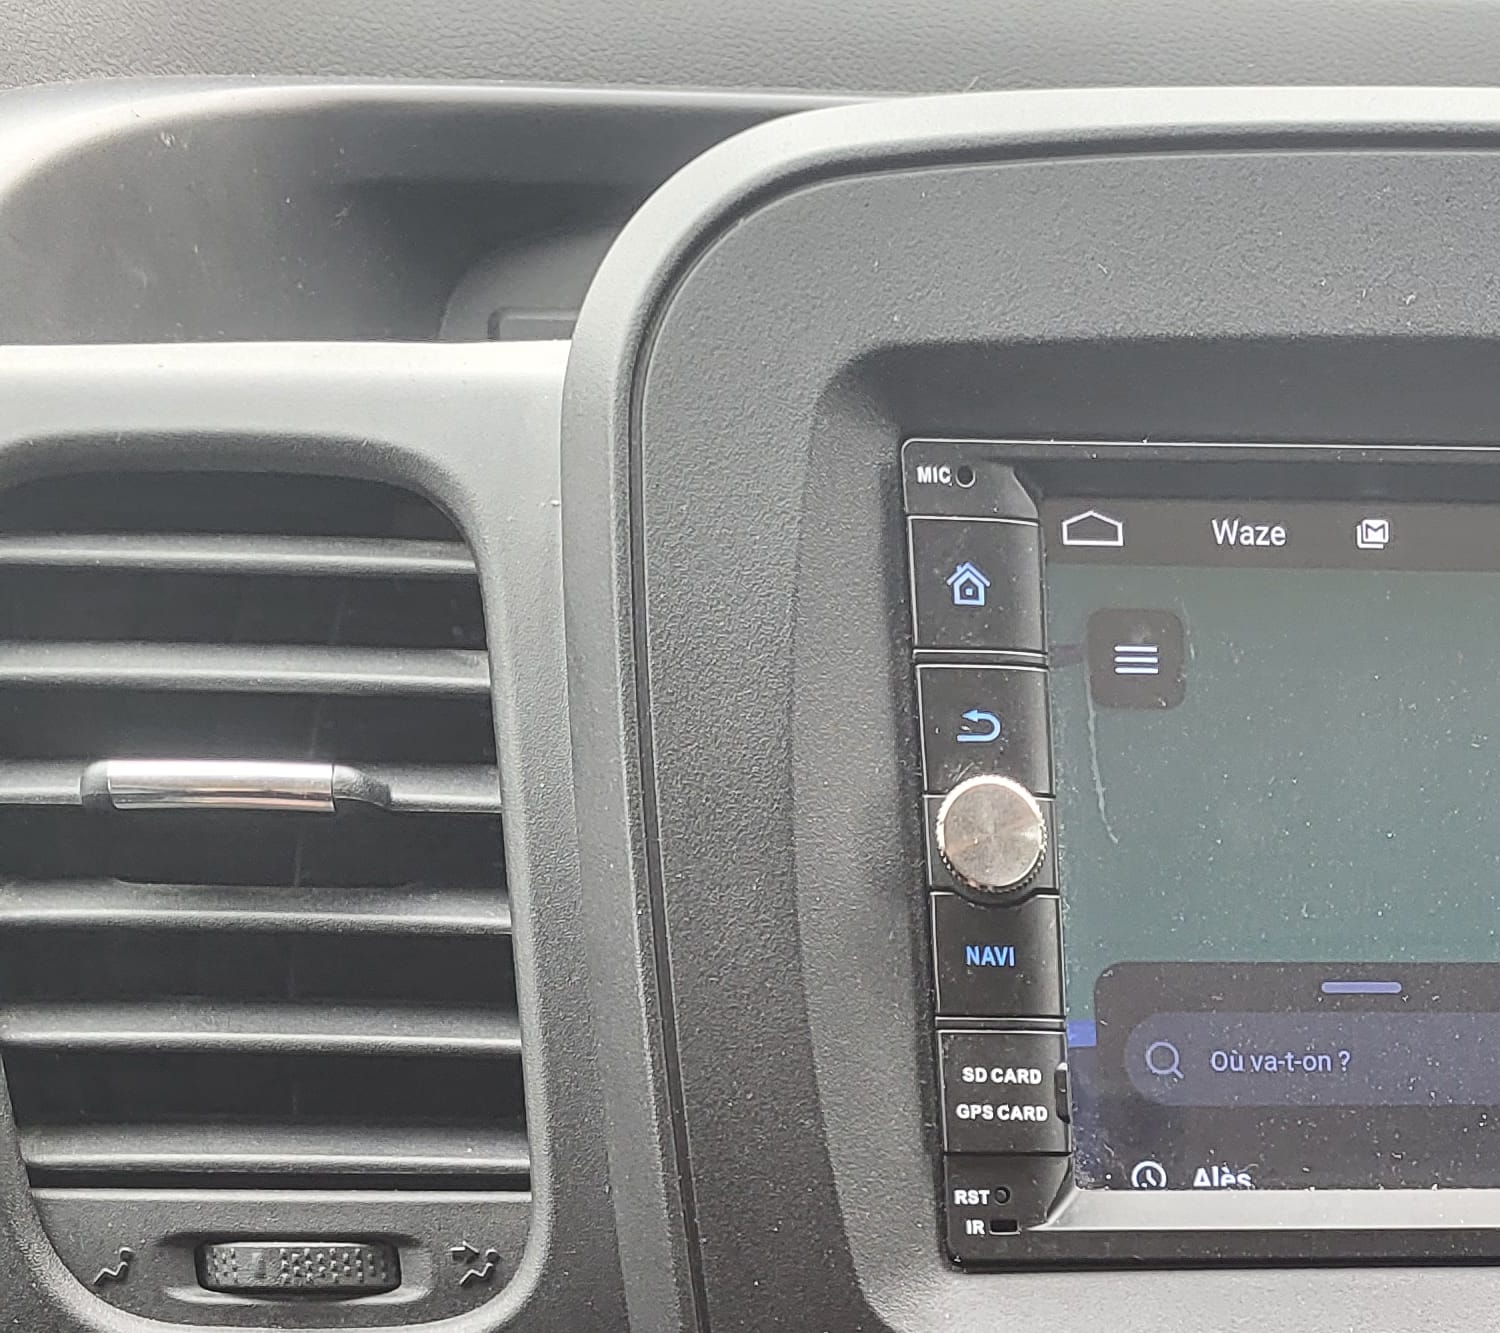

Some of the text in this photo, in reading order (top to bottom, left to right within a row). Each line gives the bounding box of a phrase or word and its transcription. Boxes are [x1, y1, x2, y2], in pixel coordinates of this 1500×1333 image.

[916, 465, 952, 485] MIC
[1211, 518, 1287, 547] Waze
[965, 945, 1016, 967] NAVI
[1210, 1050, 1244, 1072] Où
[1250, 1051, 1333, 1073] va-t-on
[962, 1066, 1043, 1085] SD CARD
[956, 1103, 1048, 1122] GPS CARD
[1192, 1163, 1252, 1188] Alès
[954, 1189, 990, 1205] RST
[965, 1219, 986, 1235] IR
